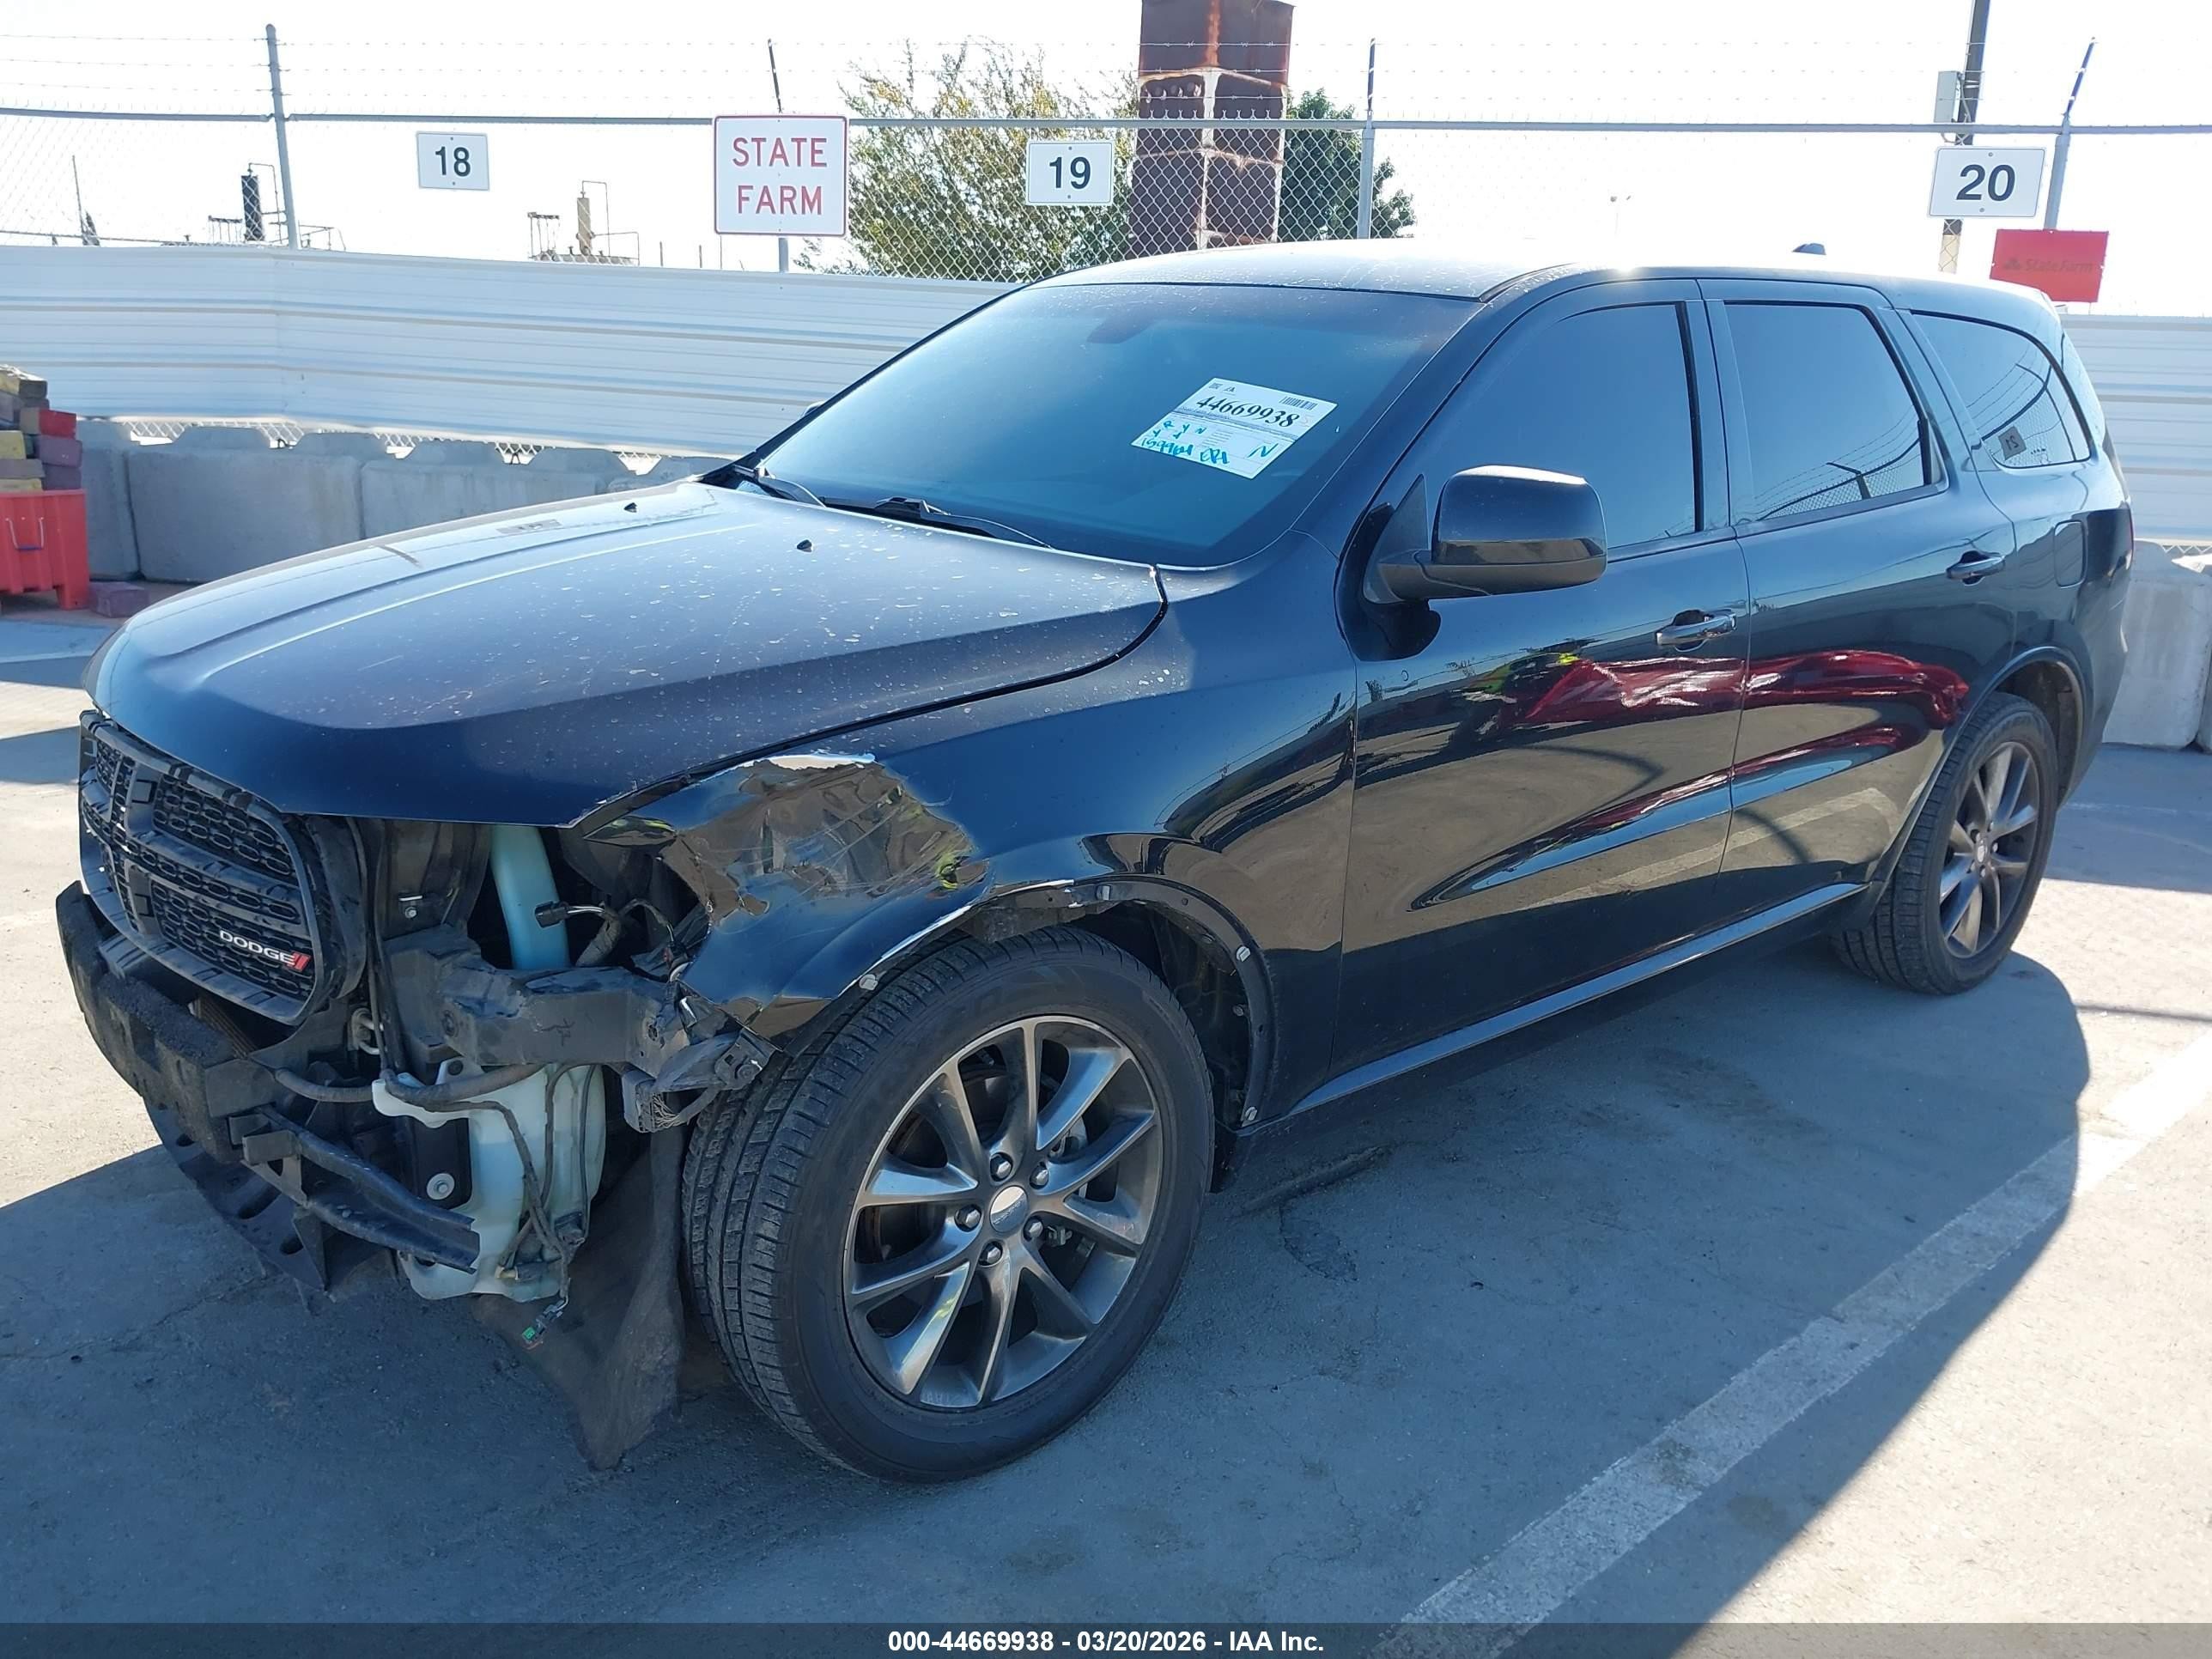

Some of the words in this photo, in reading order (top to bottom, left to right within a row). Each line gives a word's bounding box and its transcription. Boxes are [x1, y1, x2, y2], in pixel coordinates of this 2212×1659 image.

[434, 146, 471, 179] 18
[732, 137, 827, 167] STATE
[1049, 156, 1091, 190] 19
[1955, 164, 2015, 202] 20
[738, 185, 822, 215] FARM
[1196, 395, 1300, 428] 44669938
[219, 930, 295, 966] DODGE
